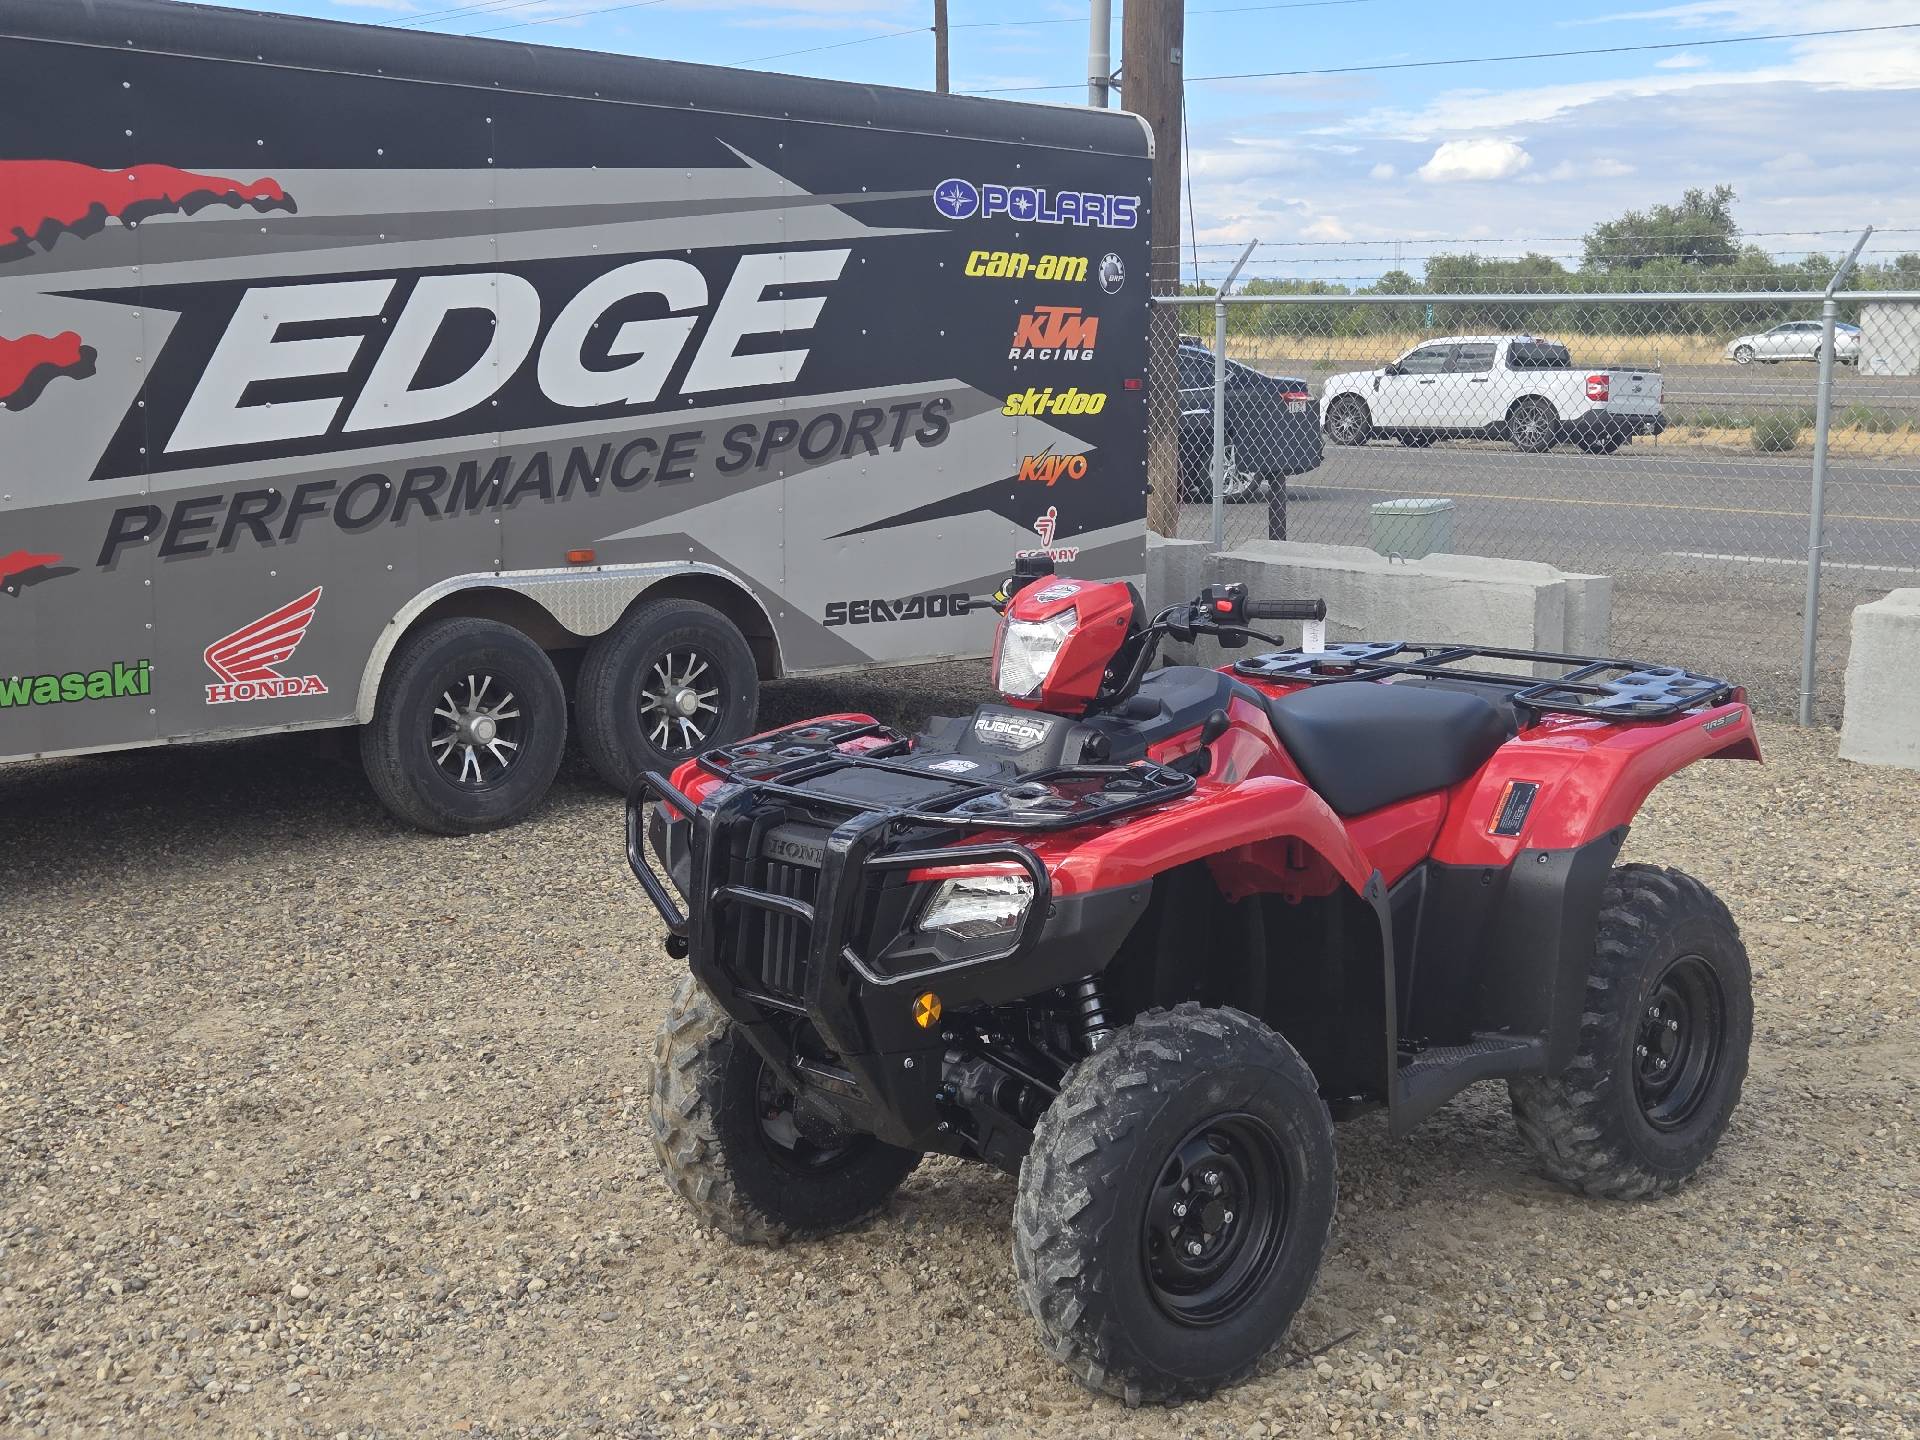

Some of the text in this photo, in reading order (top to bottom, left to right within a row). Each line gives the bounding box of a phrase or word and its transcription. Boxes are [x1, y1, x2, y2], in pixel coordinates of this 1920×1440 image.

[982, 184, 1138, 229] POLARIS
[965, 250, 1088, 282] can-am
[1012, 305, 1099, 349] KTM
[163, 248, 852, 454] EDGE
[1008, 348, 1095, 361] RACING
[1001, 387, 1107, 417] ski-doo
[1018, 444, 1088, 486] KAYO
[96, 398, 954, 570] PERFORMANCE SPORTS
[1015, 547, 1078, 563] WAY
[205, 674, 329, 705] HONDA
[974, 719, 1045, 741] RUBICON
